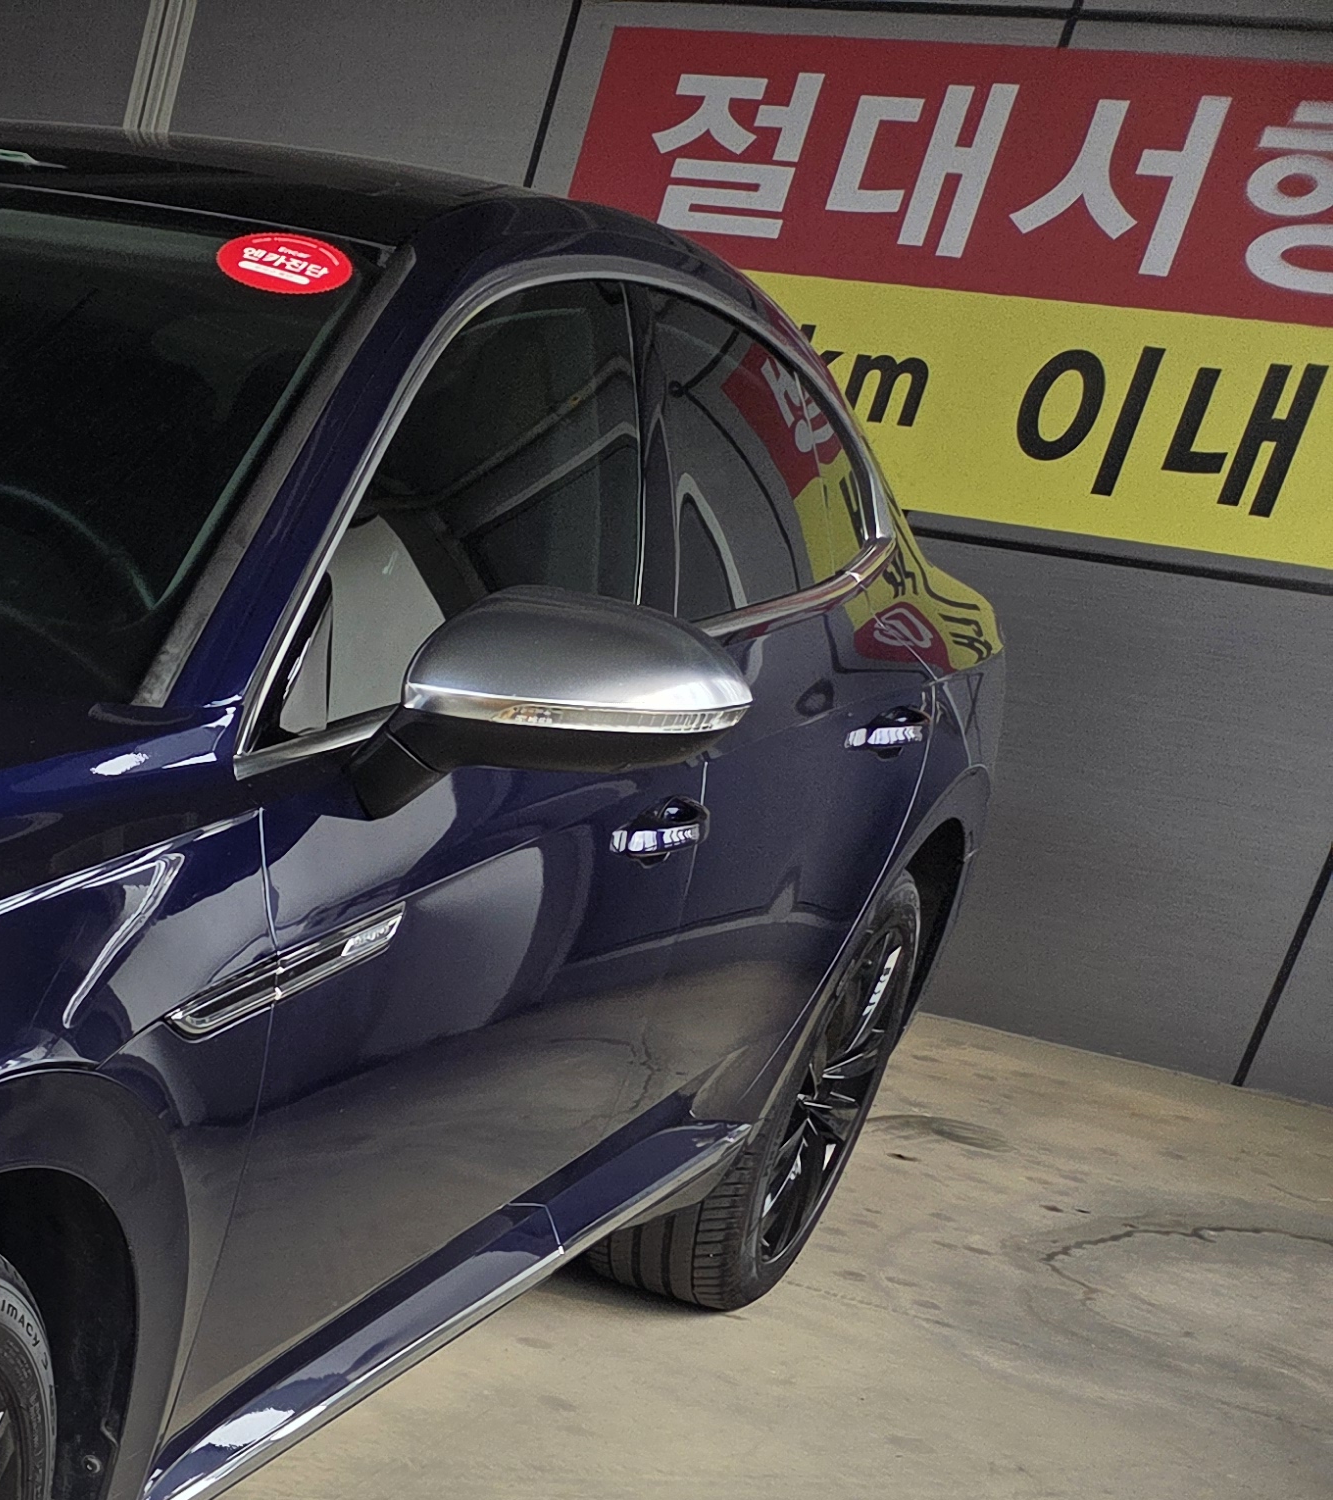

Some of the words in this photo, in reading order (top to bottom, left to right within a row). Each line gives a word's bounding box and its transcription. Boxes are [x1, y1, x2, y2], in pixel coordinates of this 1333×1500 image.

[242, 246, 330, 279] 엔카진단
[800, 324, 930, 428] m
[1016, 345, 1331, 518] 이내
